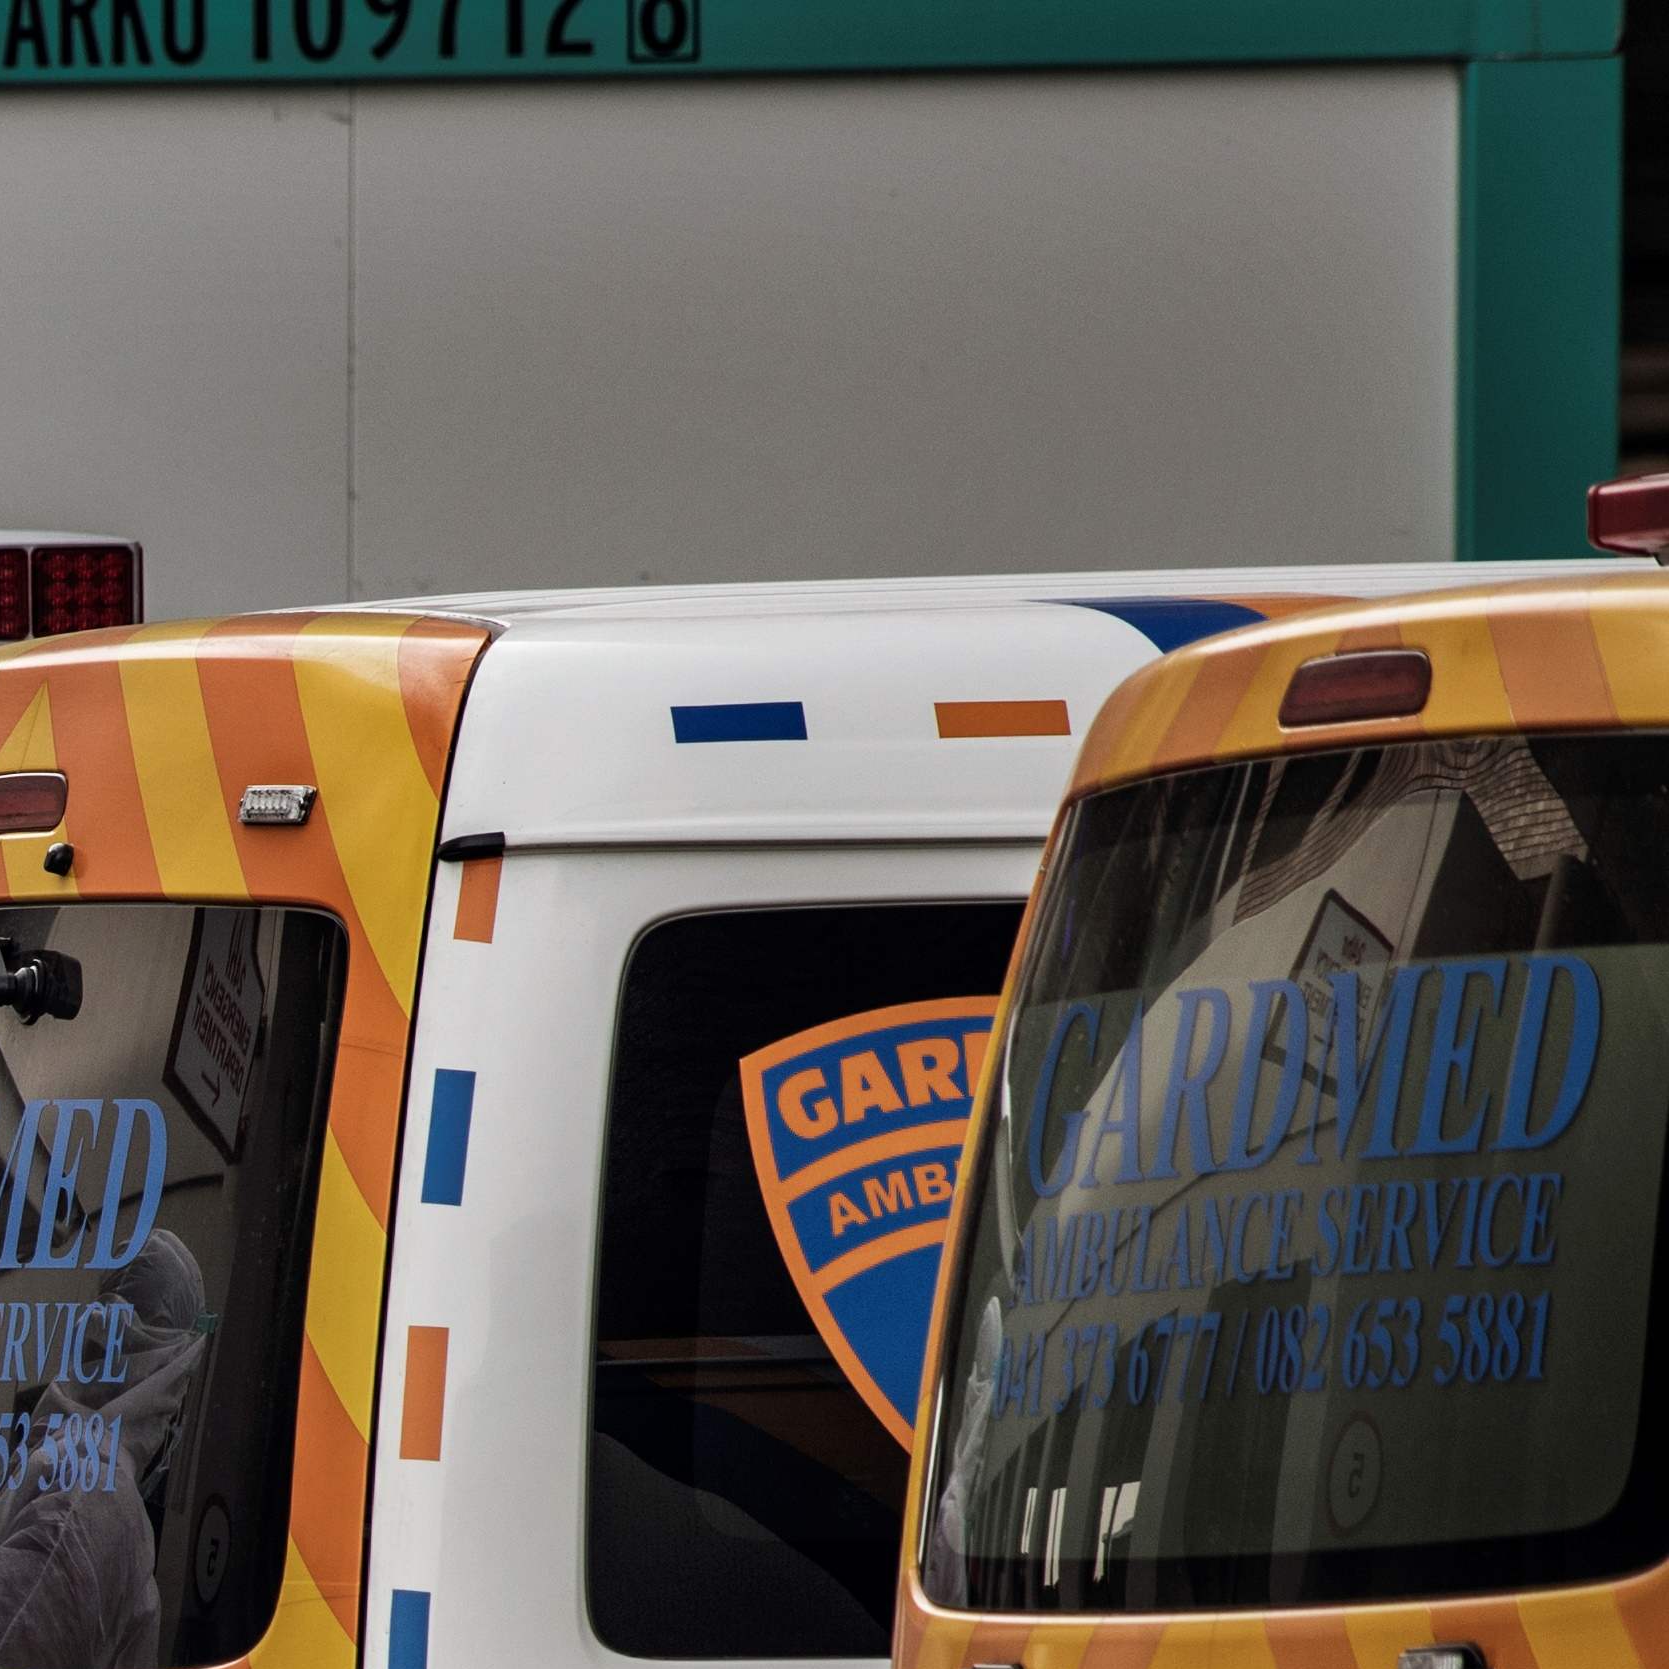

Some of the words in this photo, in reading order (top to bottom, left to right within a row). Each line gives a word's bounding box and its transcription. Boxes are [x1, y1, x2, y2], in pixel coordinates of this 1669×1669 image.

[1028, 956, 1602, 1200] GARDMED
[828, 1160, 961, 1238] AMB
[1006, 1188, 1304, 1309] AMBULANCE
[1308, 1172, 1562, 1277] SERVICE
[991, 1331, 1048, 1420] 041
[1054, 1322, 1120, 1411] 373
[1126, 1310, 1222, 1406] 6777
[1255, 1303, 1331, 1395] 082
[1341, 1297, 1423, 1390] 653
[1433, 1290, 1554, 1384] 5881
[37, 1411, 124, 1493] 5881
